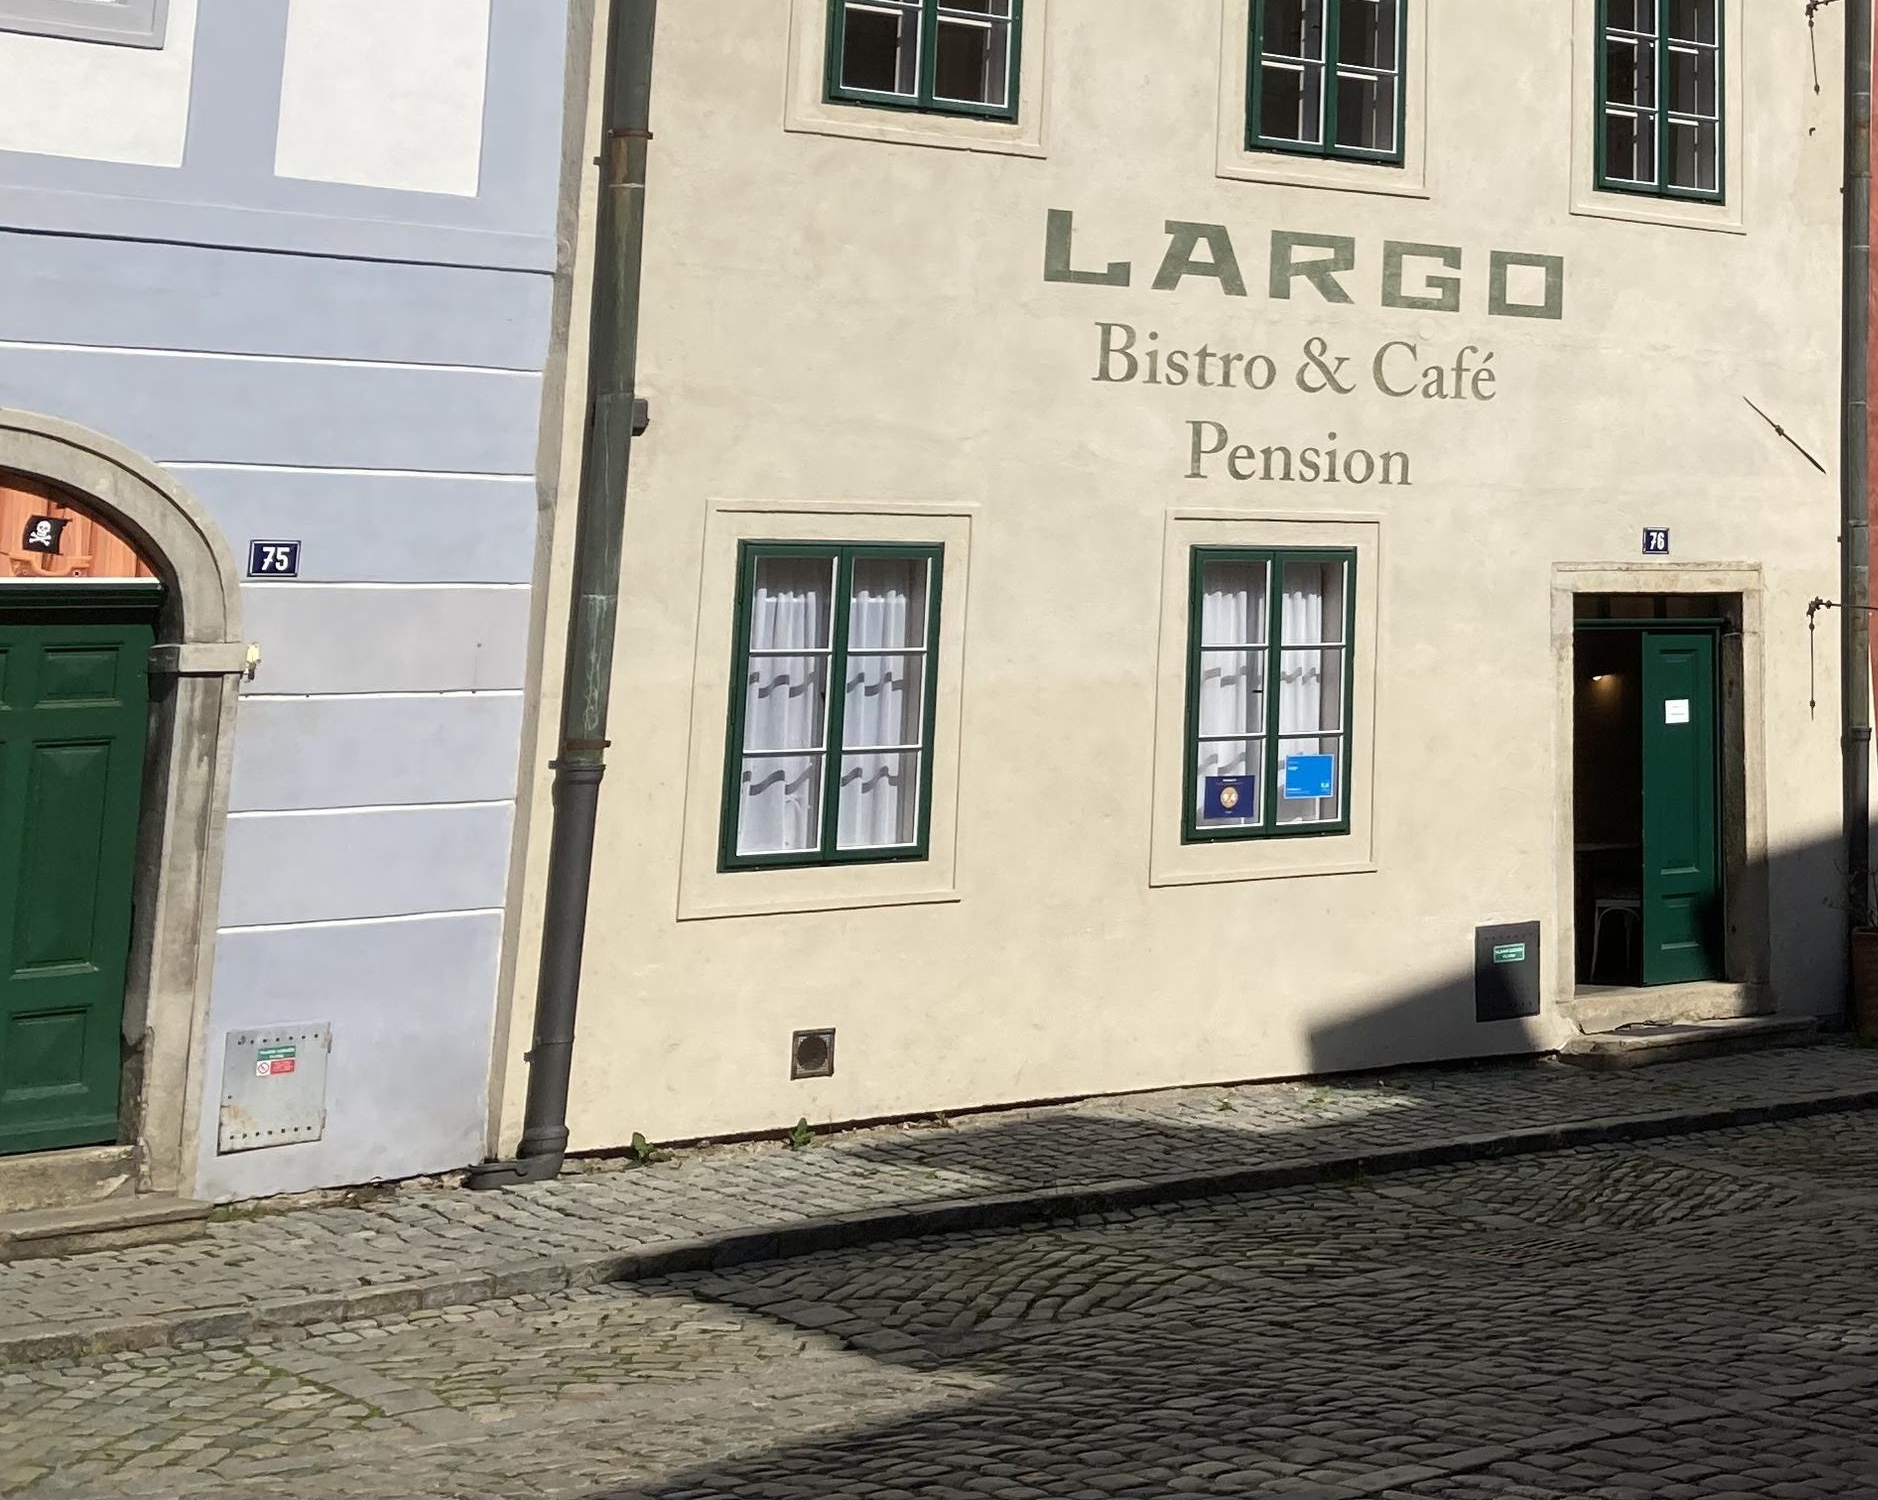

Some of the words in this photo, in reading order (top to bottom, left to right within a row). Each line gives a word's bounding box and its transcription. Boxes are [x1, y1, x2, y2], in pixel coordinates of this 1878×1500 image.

[1043, 208, 1564, 321] LARGO
[1091, 321, 1277, 391] Bistro
[1295, 337, 1358, 395] &
[1372, 341, 1498, 401] Café
[1183, 420, 1413, 486] Pension
[261, 546, 290, 570] 75
[1649, 532, 1665, 550] 76
